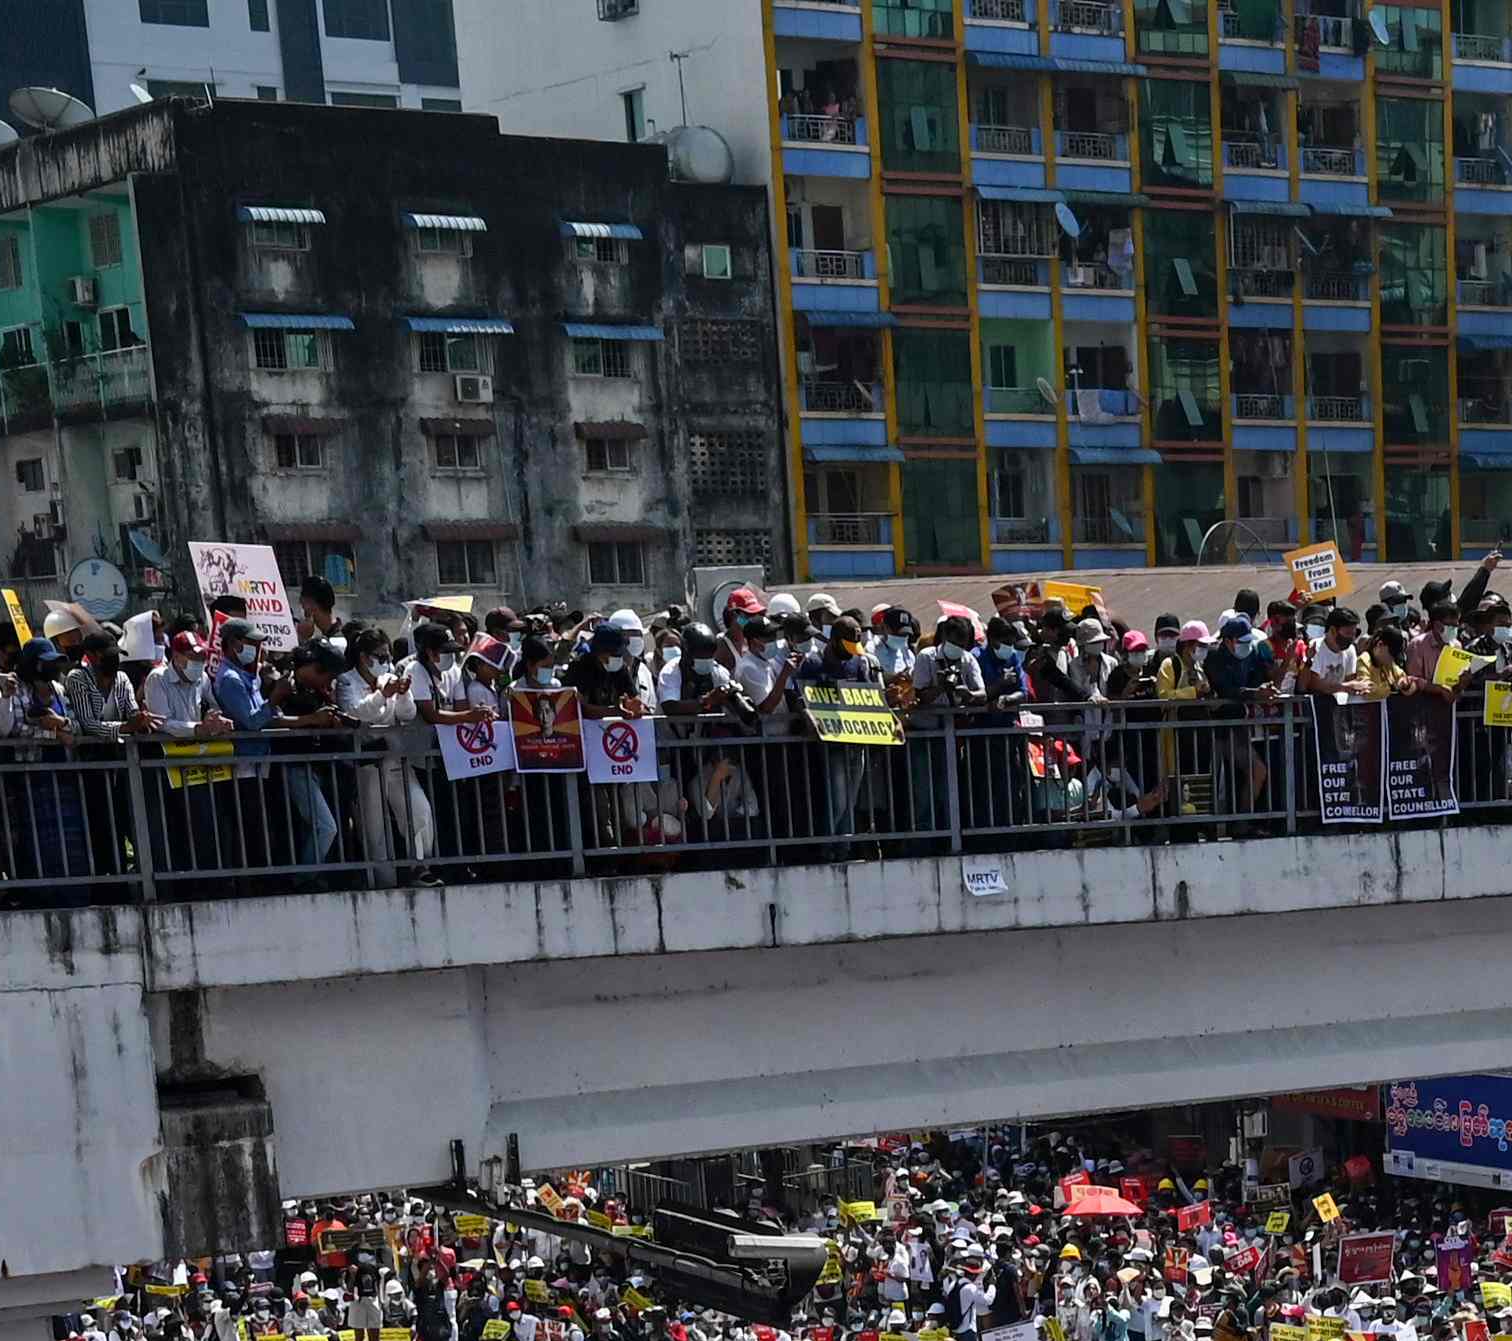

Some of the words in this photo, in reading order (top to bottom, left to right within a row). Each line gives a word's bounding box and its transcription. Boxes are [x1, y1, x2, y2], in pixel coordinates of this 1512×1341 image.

[238, 580, 277, 596] MRTV
[804, 686, 841, 706] GIVE
[841, 687, 885, 707] BACK
[815, 717, 894, 738] DEMOCRACY
[469, 753, 494, 770] END
[1322, 763, 1346, 775] FREE
[1390, 760, 1417, 773] FREE
[613, 763, 637, 777] END
[1390, 774, 1414, 786] OUR
[1391, 787, 1426, 800] STATE
[1393, 798, 1457, 816] COUNSELLOR
[967, 870, 1000, 885] MRTV
